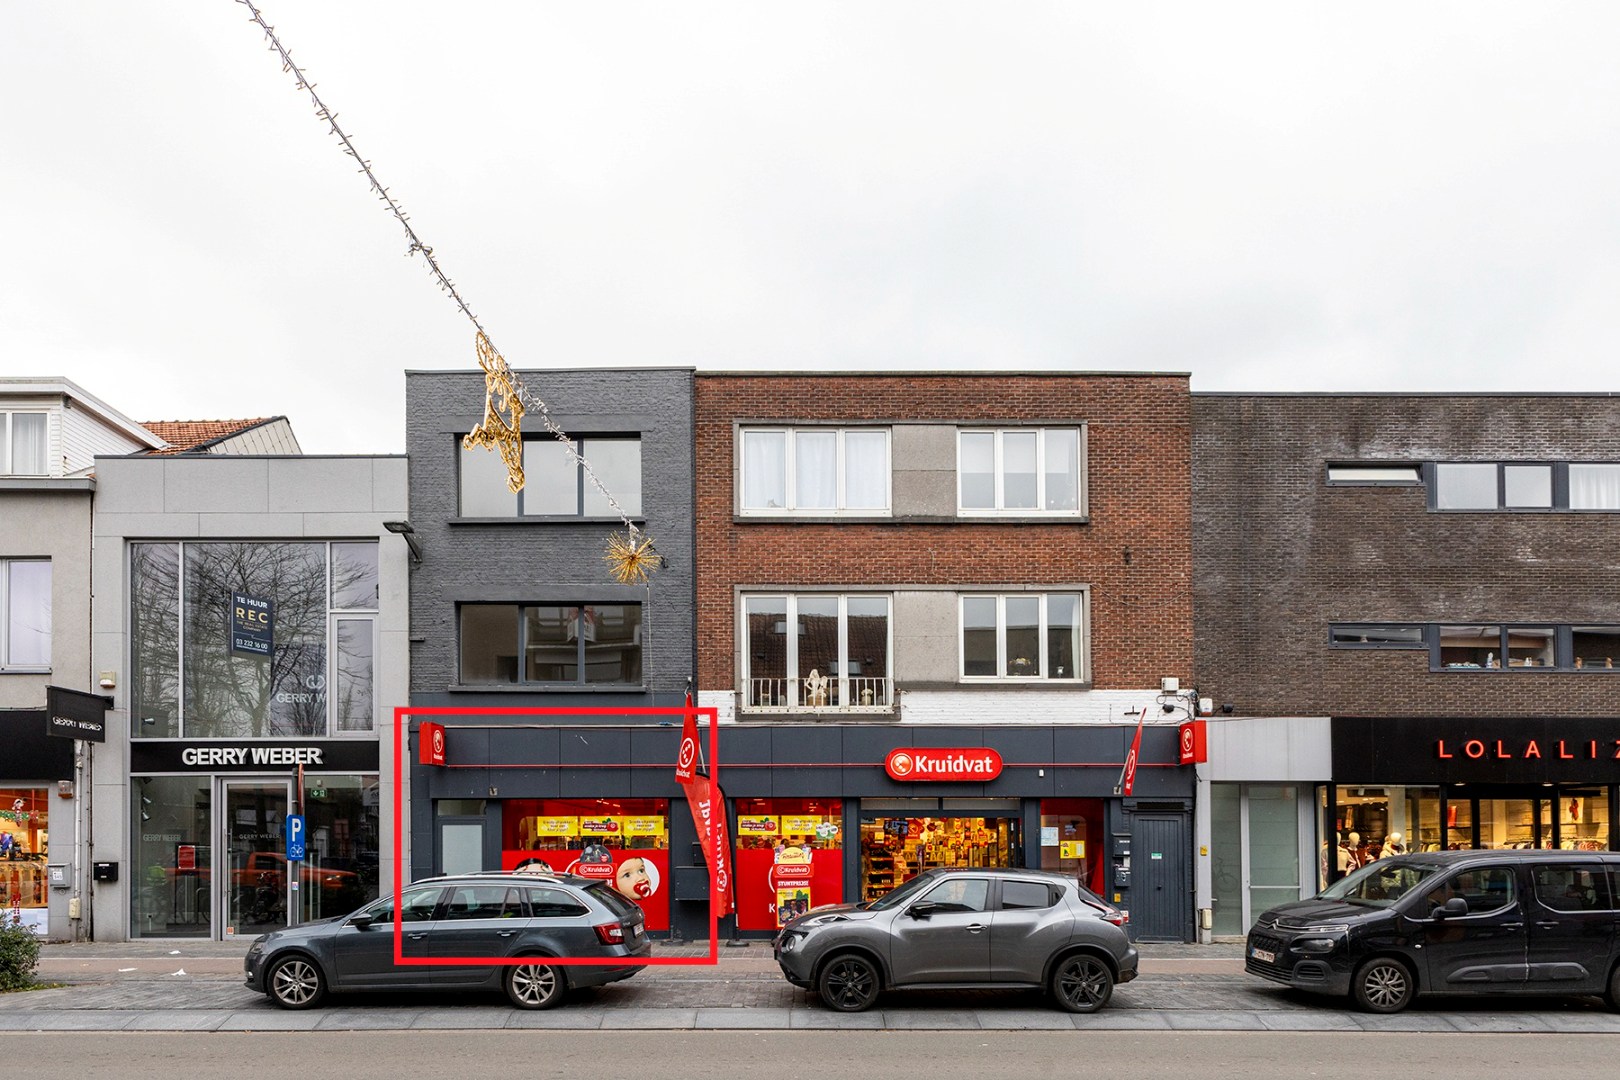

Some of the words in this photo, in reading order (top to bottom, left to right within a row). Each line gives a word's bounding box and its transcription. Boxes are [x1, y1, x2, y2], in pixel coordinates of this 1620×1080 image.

[236, 596, 246, 604] TE
[247, 598, 268, 608] HUUR
[236, 607, 268, 624] REC
[276, 693, 314, 703] GERRY
[182, 748, 248, 765] GERRY
[251, 748, 324, 765] WEBER
[915, 755, 993, 773] Kruidvat
[291, 818, 302, 842] P
[587, 865, 610, 873] Kruidvat
